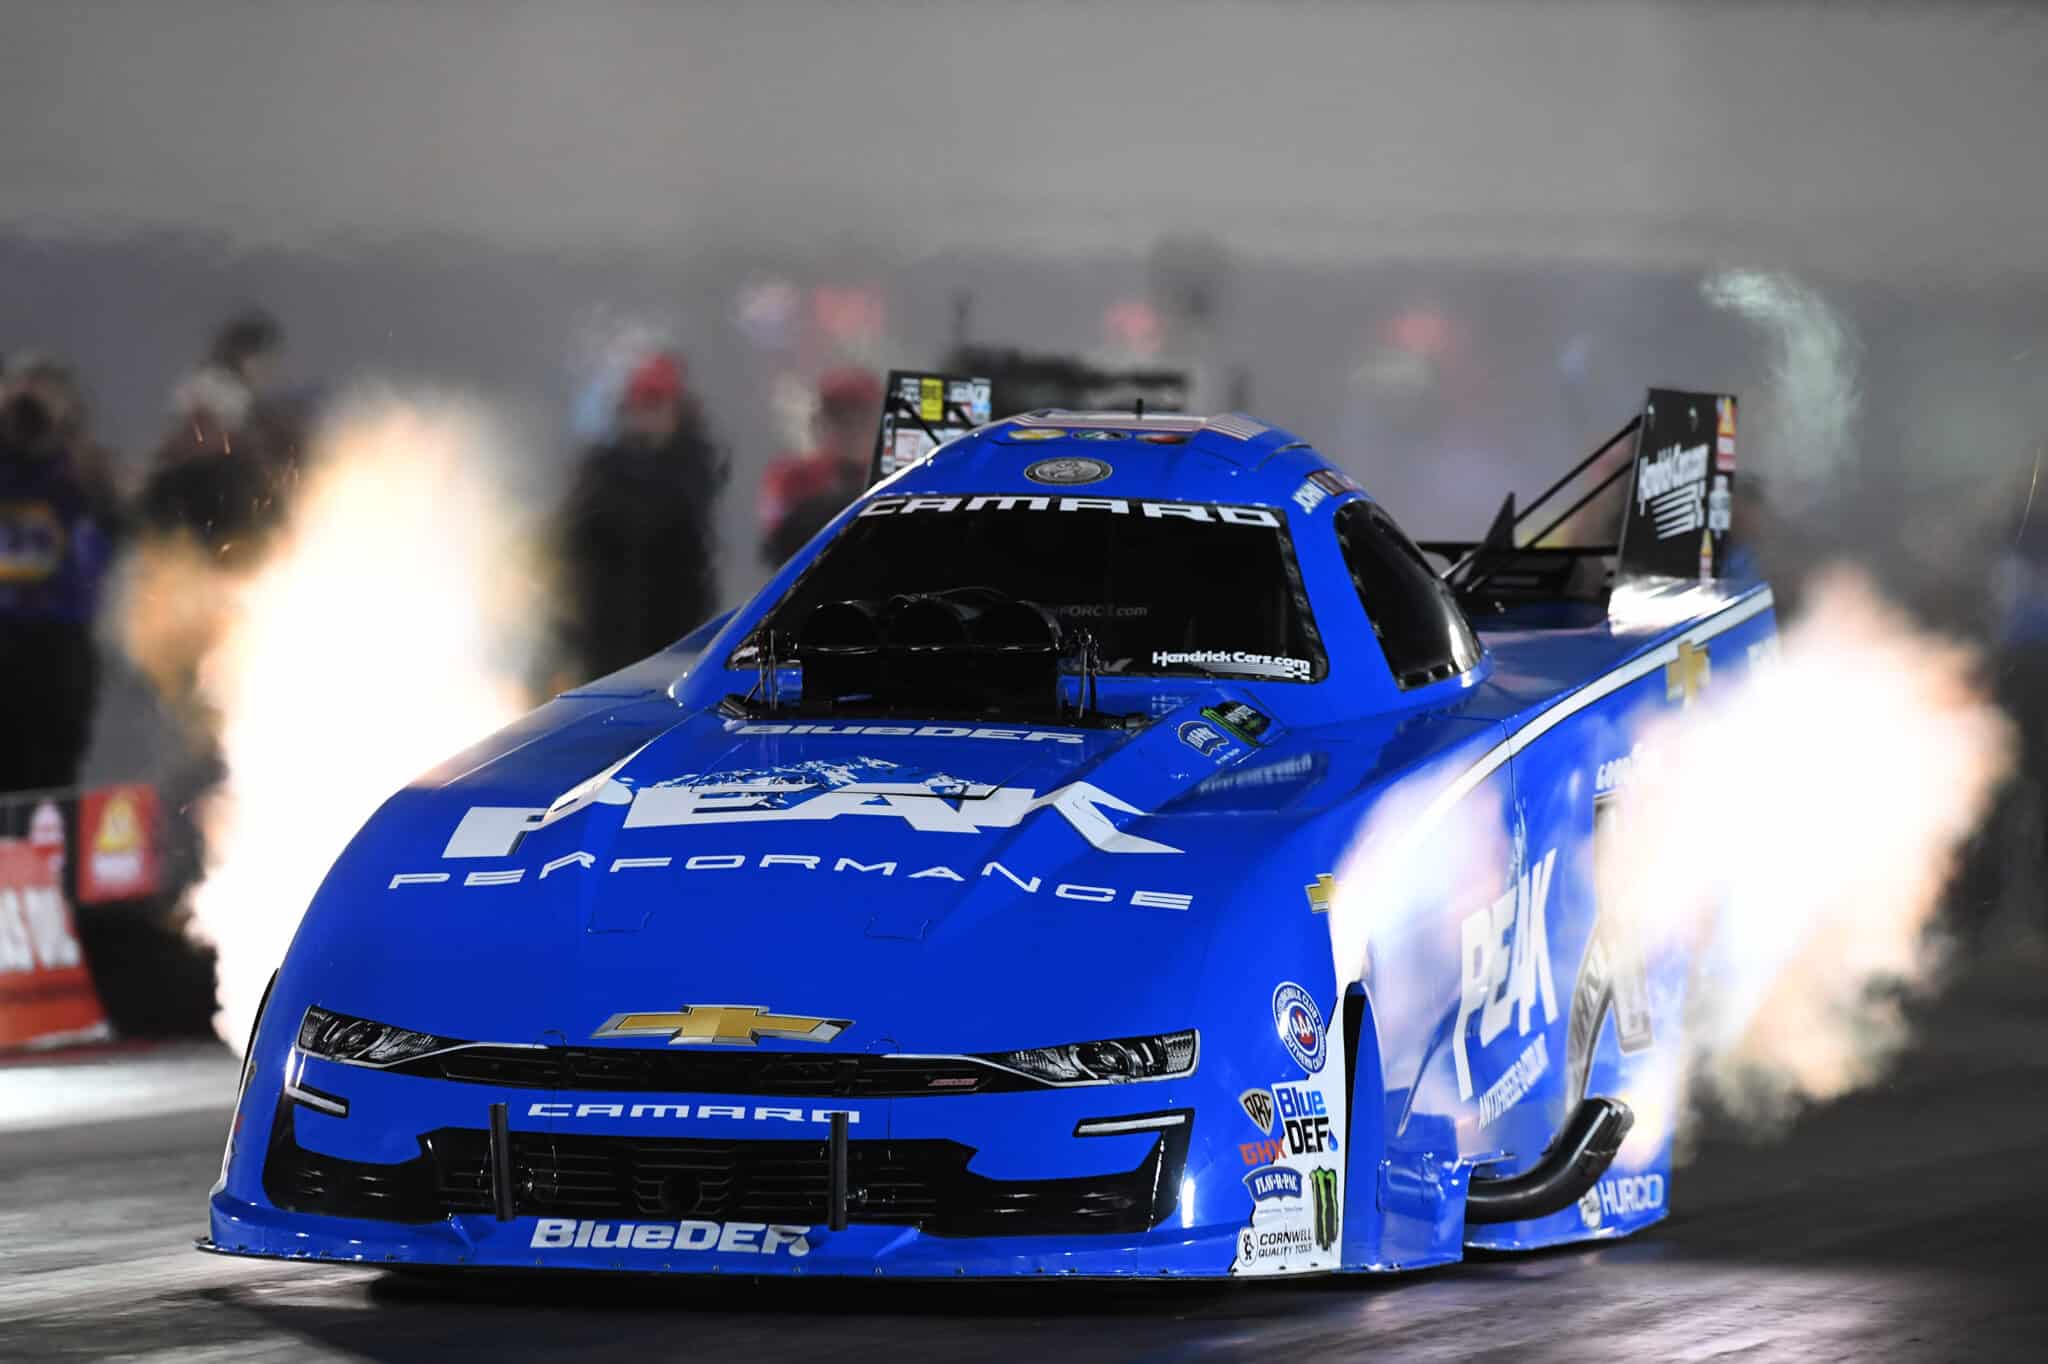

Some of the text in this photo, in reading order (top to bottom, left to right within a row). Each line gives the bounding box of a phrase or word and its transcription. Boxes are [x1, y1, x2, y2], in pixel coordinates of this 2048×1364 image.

[857, 496, 1281, 527] CAMARO
[442, 775, 1186, 860] PEAK
[388, 851, 1194, 911] PERFORMANCE
[1452, 848, 1560, 1102] PEAK
[528, 1103, 860, 1124] CAMARO
[1276, 1087, 1327, 1117] Blue
[1240, 1138, 1287, 1165] GHX
[1285, 1117, 1329, 1155] DEF
[530, 1218, 811, 1256] BlueDEF
[1259, 1245, 1292, 1258] QUALITY
[1260, 1228, 1311, 1246] CORNWELL
